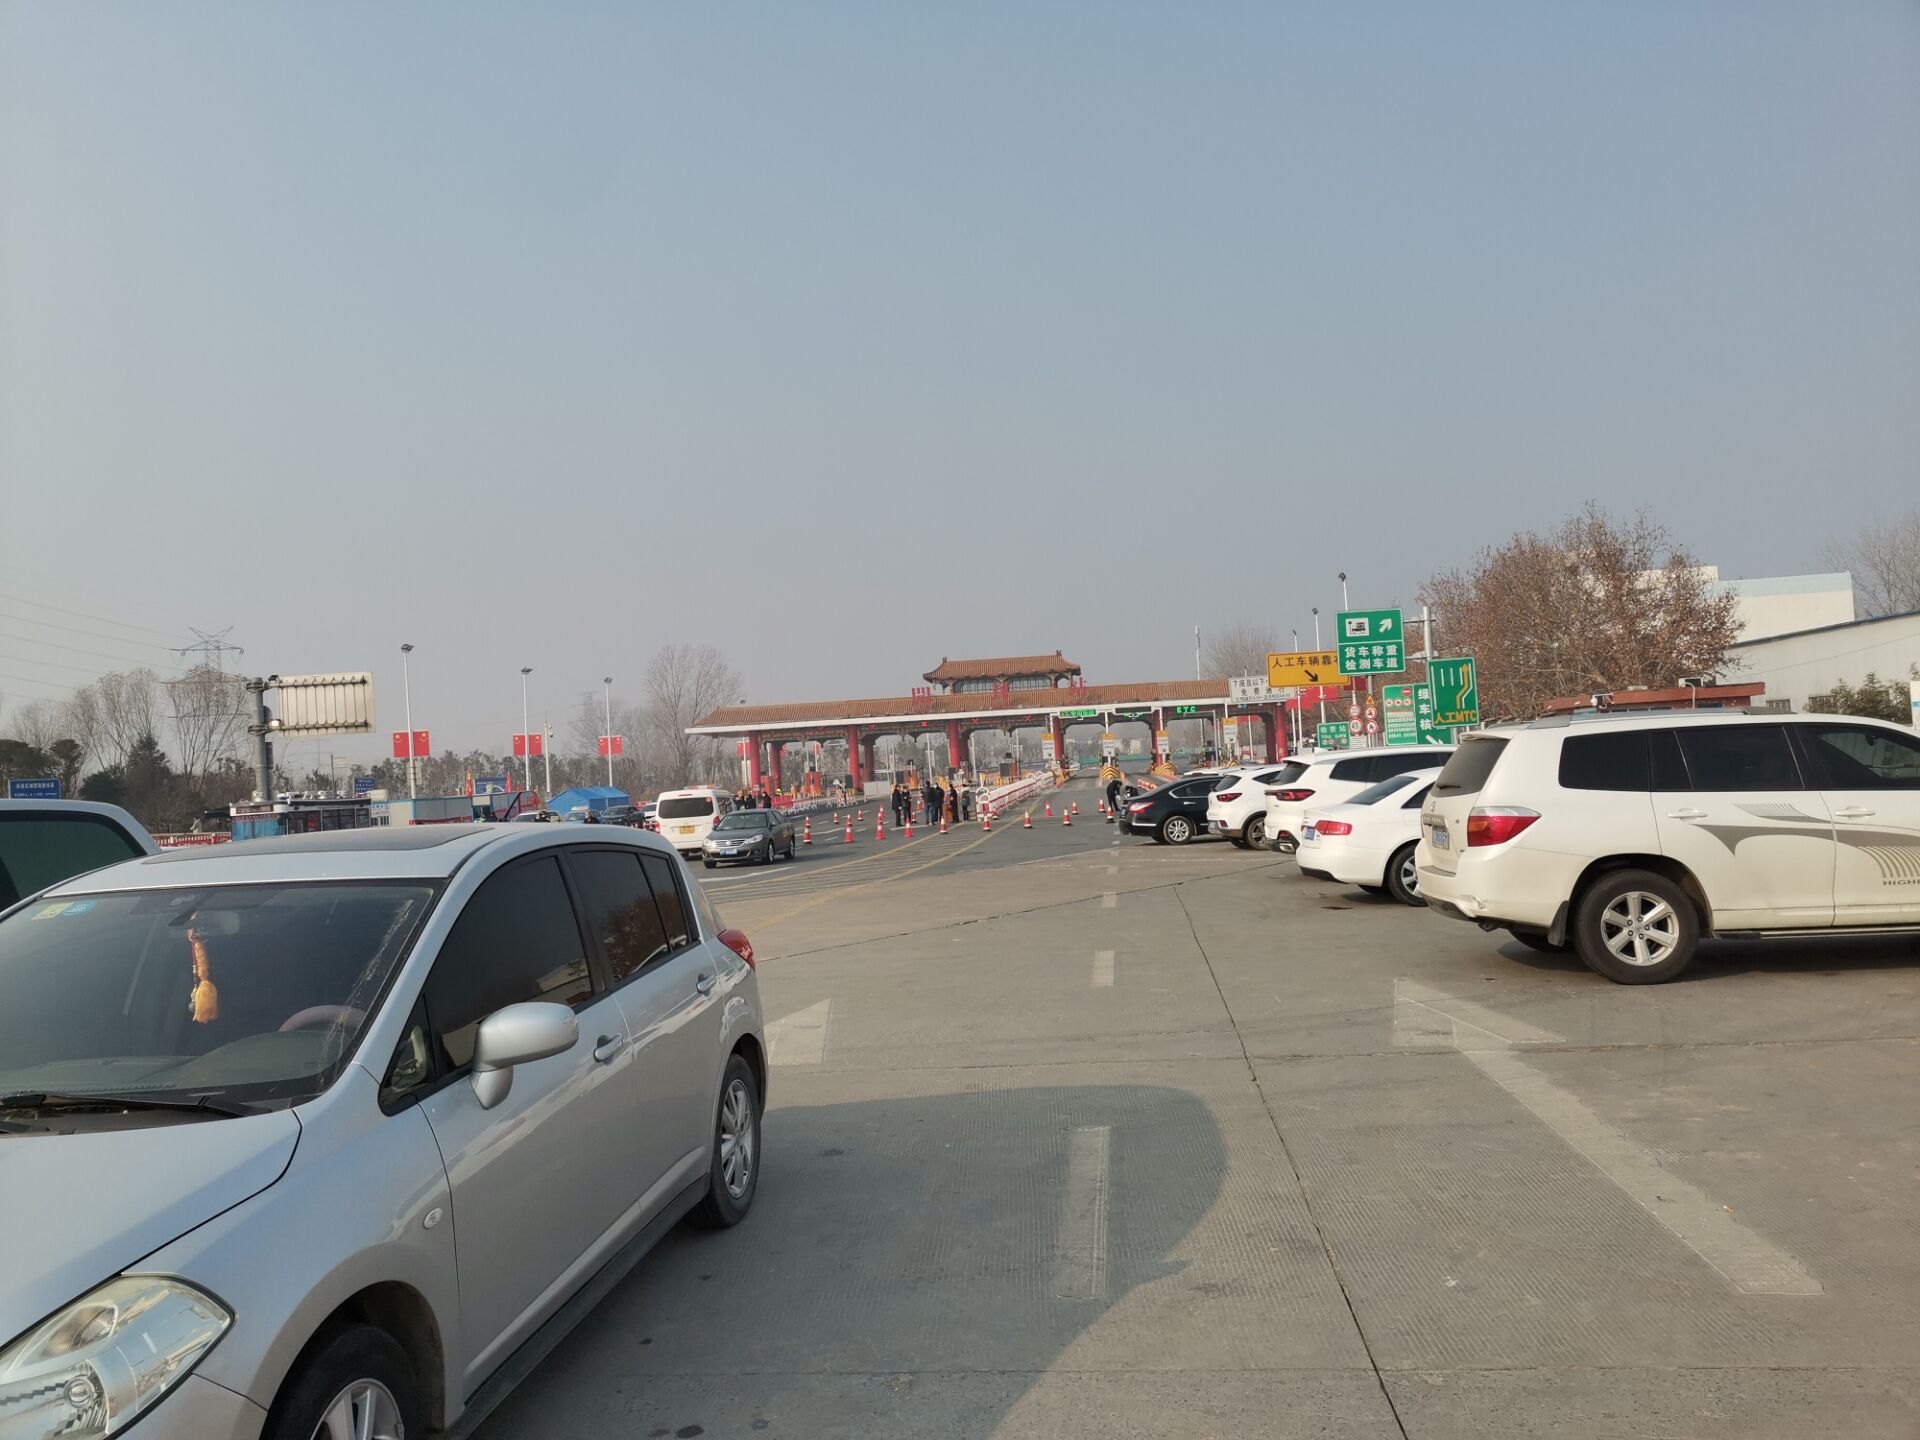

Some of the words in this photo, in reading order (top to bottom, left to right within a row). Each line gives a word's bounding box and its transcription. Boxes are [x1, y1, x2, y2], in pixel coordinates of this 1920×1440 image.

[1344, 645, 1398, 658] 货车称重
[1272, 655, 1339, 668] 人工车辆靠
[1345, 657, 1398, 670] 检测车道
[1232, 678, 1268, 688] 7座及以下
[1177, 706, 1196, 714] ETC
[1434, 711, 1478, 724] 人工MTC
